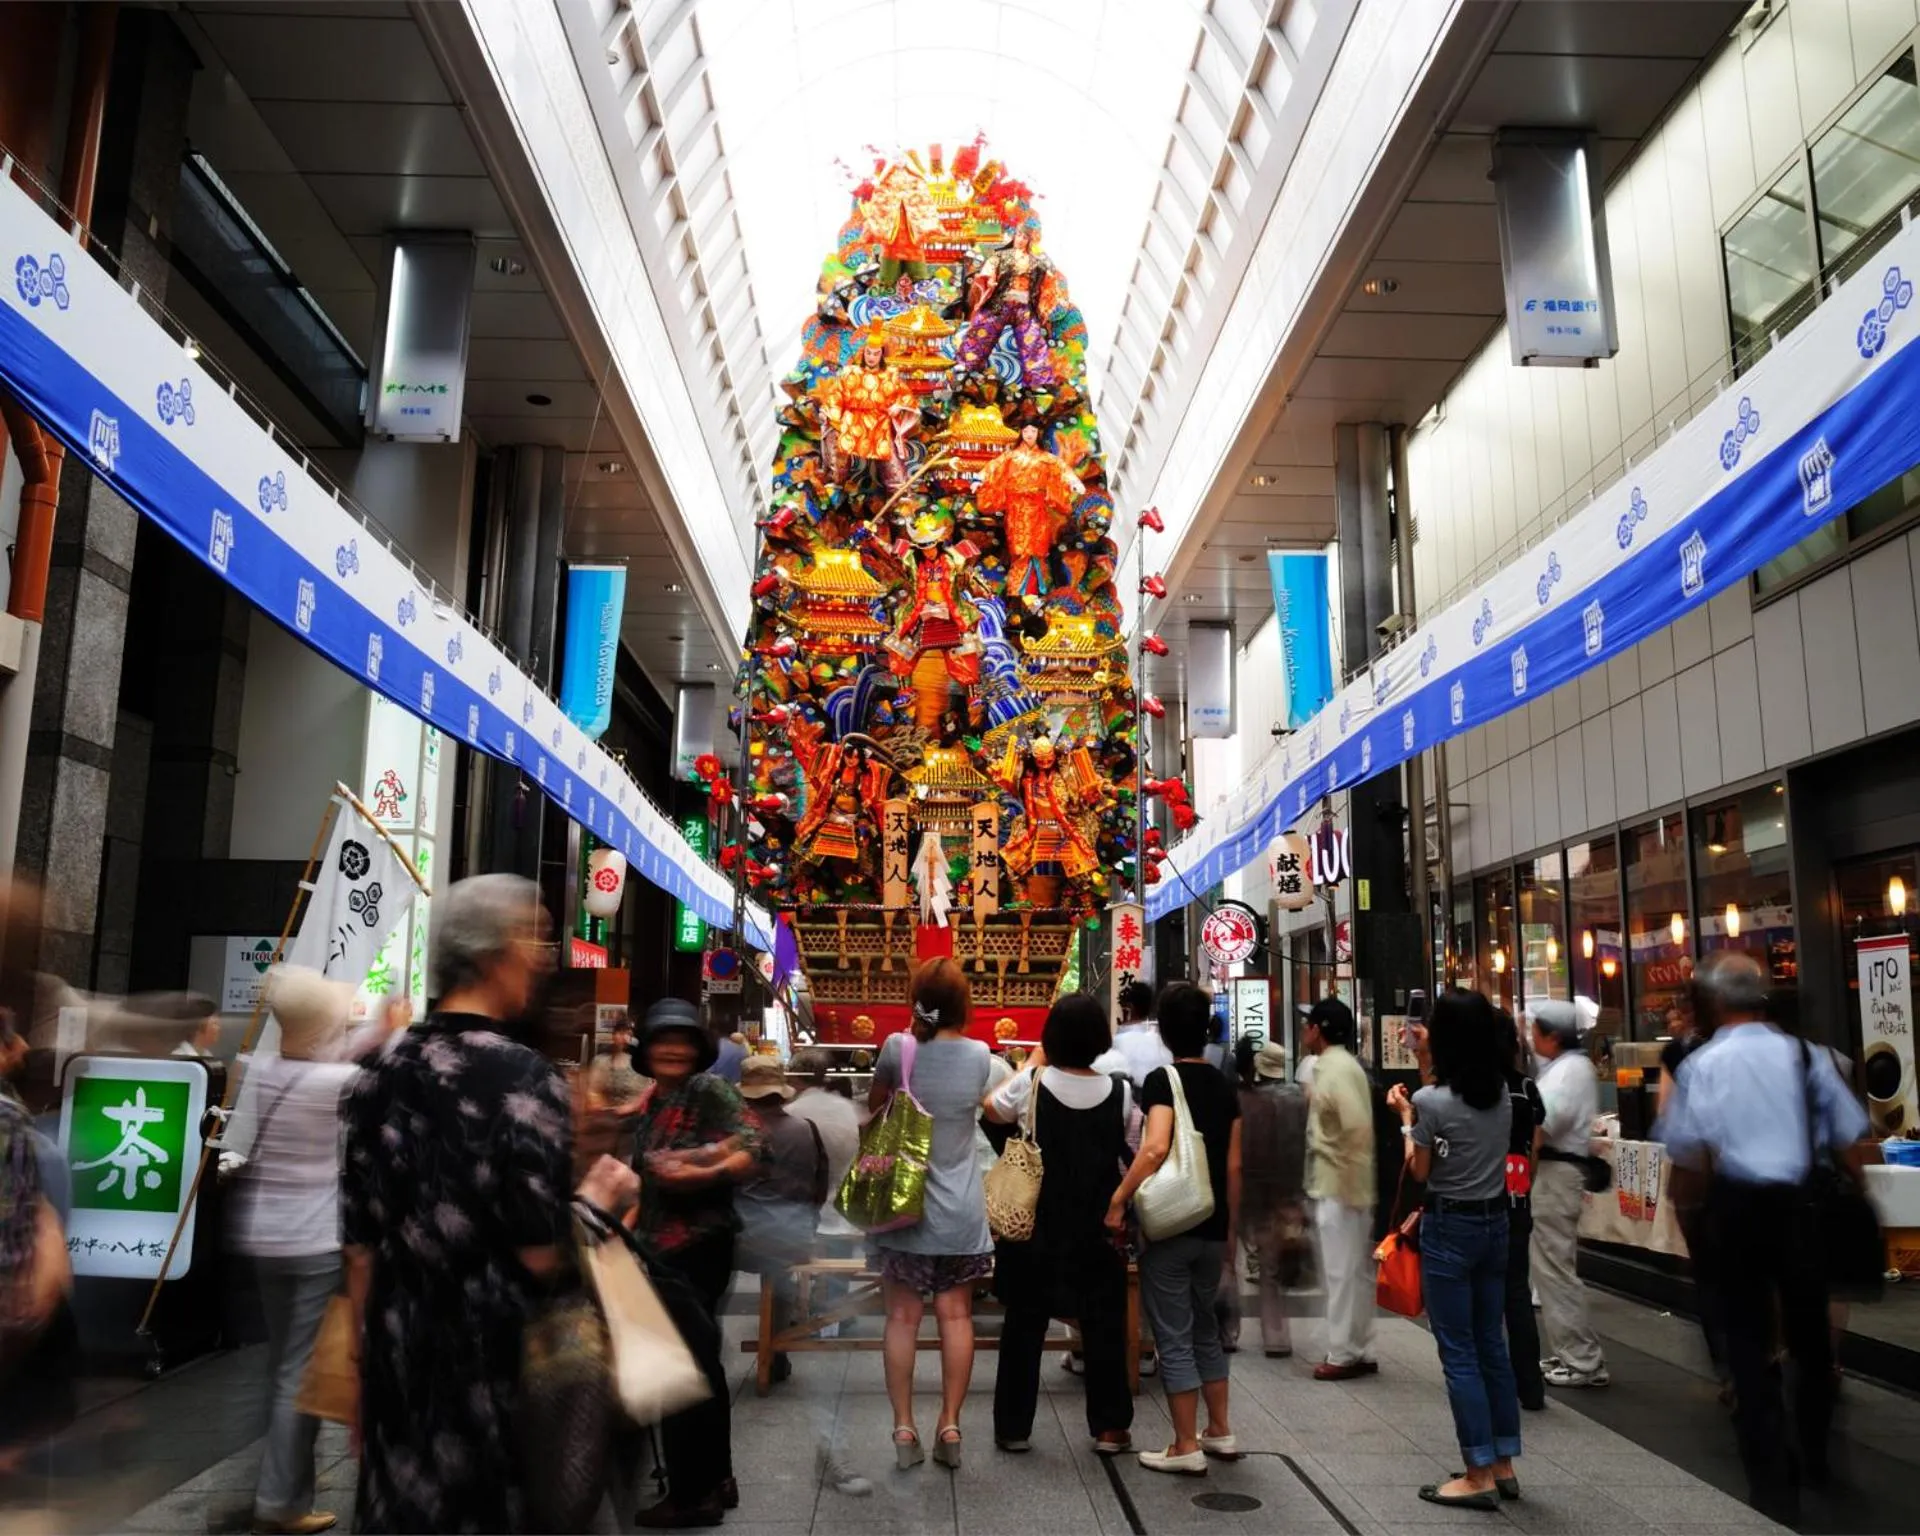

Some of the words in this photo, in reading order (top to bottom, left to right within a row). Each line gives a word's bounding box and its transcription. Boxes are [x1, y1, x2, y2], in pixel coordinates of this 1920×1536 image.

[1543, 300, 1597, 312] 福岡銀行
[595, 640, 615, 707] Kawabata
[885, 812, 908, 883] 天地人
[975, 818, 998, 898] 天地人
[1114, 913, 1142, 970] 奉納
[1868, 957, 1899, 997] 170
[71, 1086, 170, 1201] 茶
